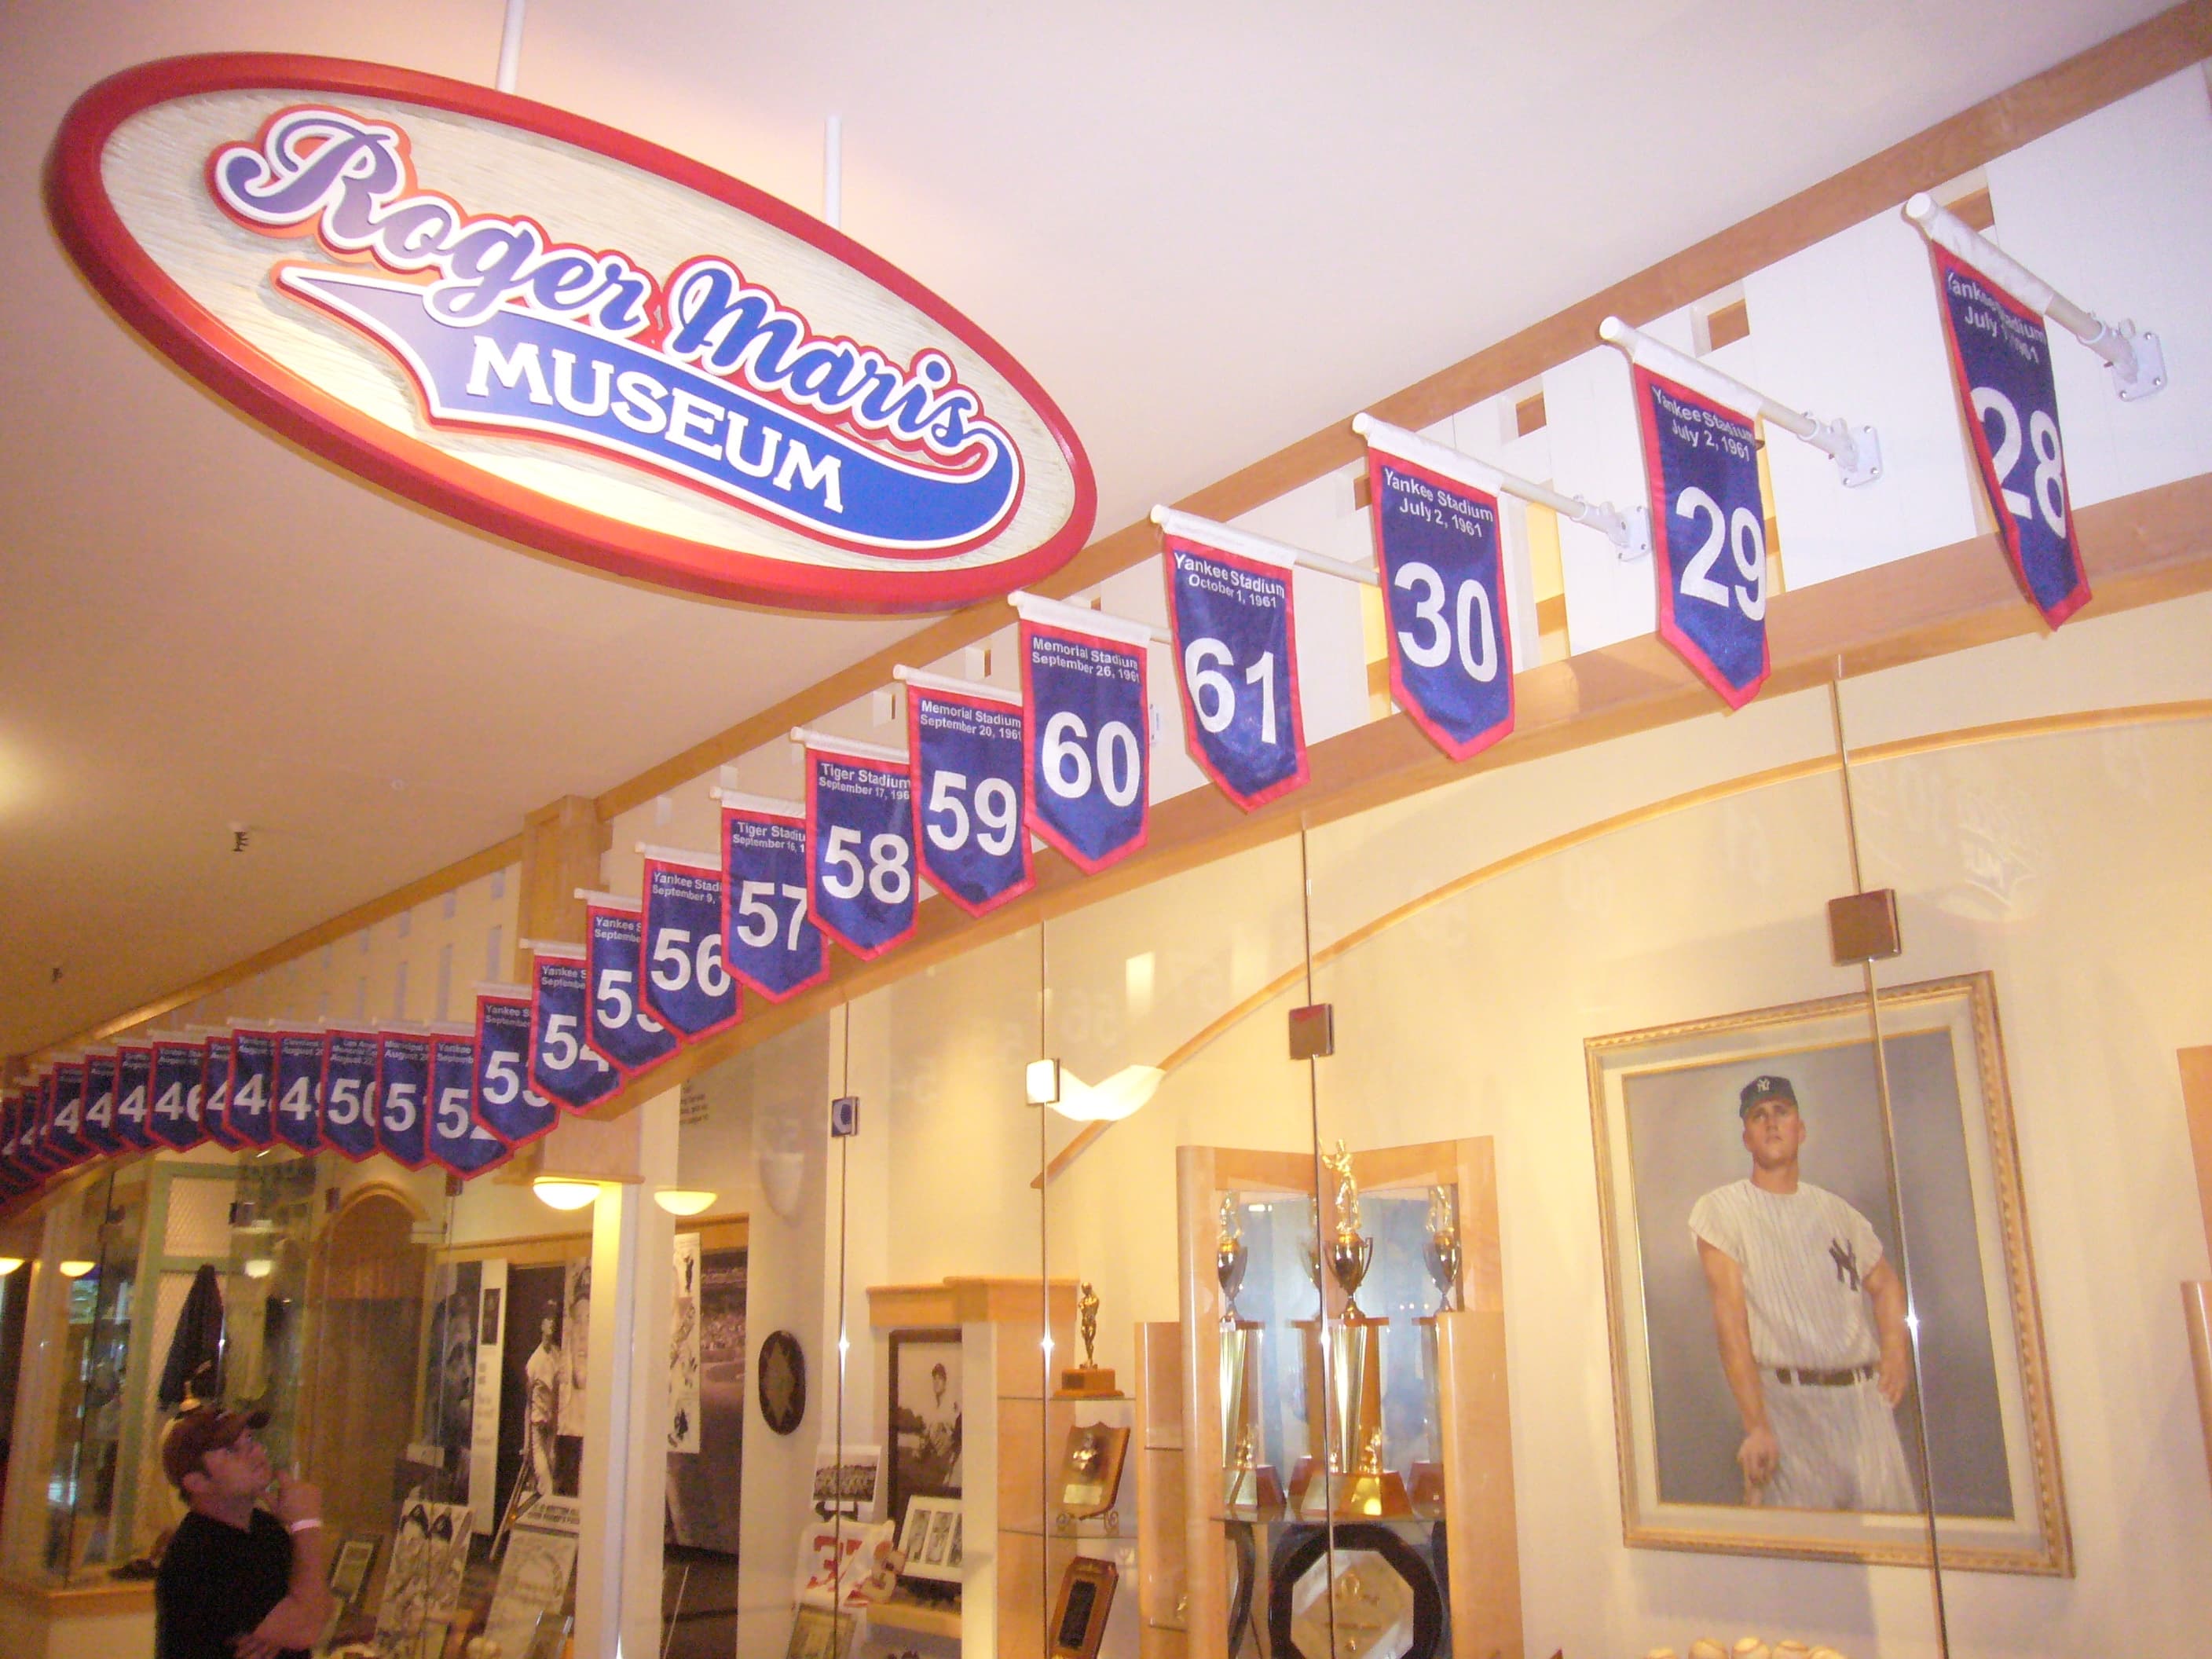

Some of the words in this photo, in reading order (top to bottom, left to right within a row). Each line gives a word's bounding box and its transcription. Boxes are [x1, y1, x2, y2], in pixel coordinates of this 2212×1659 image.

[218, 114, 648, 333] Roger
[668, 264, 978, 452] Maris
[1965, 306, 1998, 337] July
[1652, 386, 1701, 422] Yankee
[467, 335, 843, 514] MUSEUM
[1672, 419, 1699, 447] July
[1704, 430, 1719, 451] 2,
[1722, 436, 1750, 462] 1961
[1970, 386, 2066, 539] 28
[1385, 467, 1434, 501] Yankee
[1437, 490, 1493, 522] Stadium
[1400, 498, 1431, 522] July
[1434, 510, 1448, 528] 2,
[1452, 515, 1482, 537] 1961
[1676, 486, 1765, 621] 29
[1174, 552, 1229, 580] Yankee
[1230, 570, 1285, 599] Stadium
[1188, 574, 1234, 598] October
[1236, 590, 1246, 605] 1,
[1249, 594, 1276, 608] 1961
[1394, 562, 1498, 683] 30
[1032, 652, 1093, 674] September
[1096, 665, 1115, 679] 26,
[1033, 637, 1088, 660] Memorial
[1090, 650, 1138, 670] Stadium
[1185, 638, 1276, 744] 61
[921, 700, 972, 720] Memorial
[975, 711, 1021, 728] Stadium
[921, 714, 977, 734] September
[979, 725, 995, 738] 20,
[821, 763, 855, 781] Tiger
[858, 770, 910, 789] Stadium
[1042, 711, 1140, 807] 60
[819, 776, 872, 795] September
[891, 790, 910, 800] 196
[738, 822, 767, 837] Tiger
[771, 826, 805, 842] Stadiu
[927, 770, 1016, 855] 59
[733, 833, 785, 848] September
[654, 871, 692, 888] Yankee
[822, 826, 910, 904] 58
[653, 884, 704, 902] September
[595, 928, 641, 943] Septembe
[596, 917, 634, 931] Yankee
[737, 880, 807, 951] 57
[542, 965, 577, 977] Yankee
[650, 928, 731, 998] 56
[234, 1074, 273, 1115] 4
[280, 1076, 320, 1121] 4
[383, 1083, 427, 1132] 5
